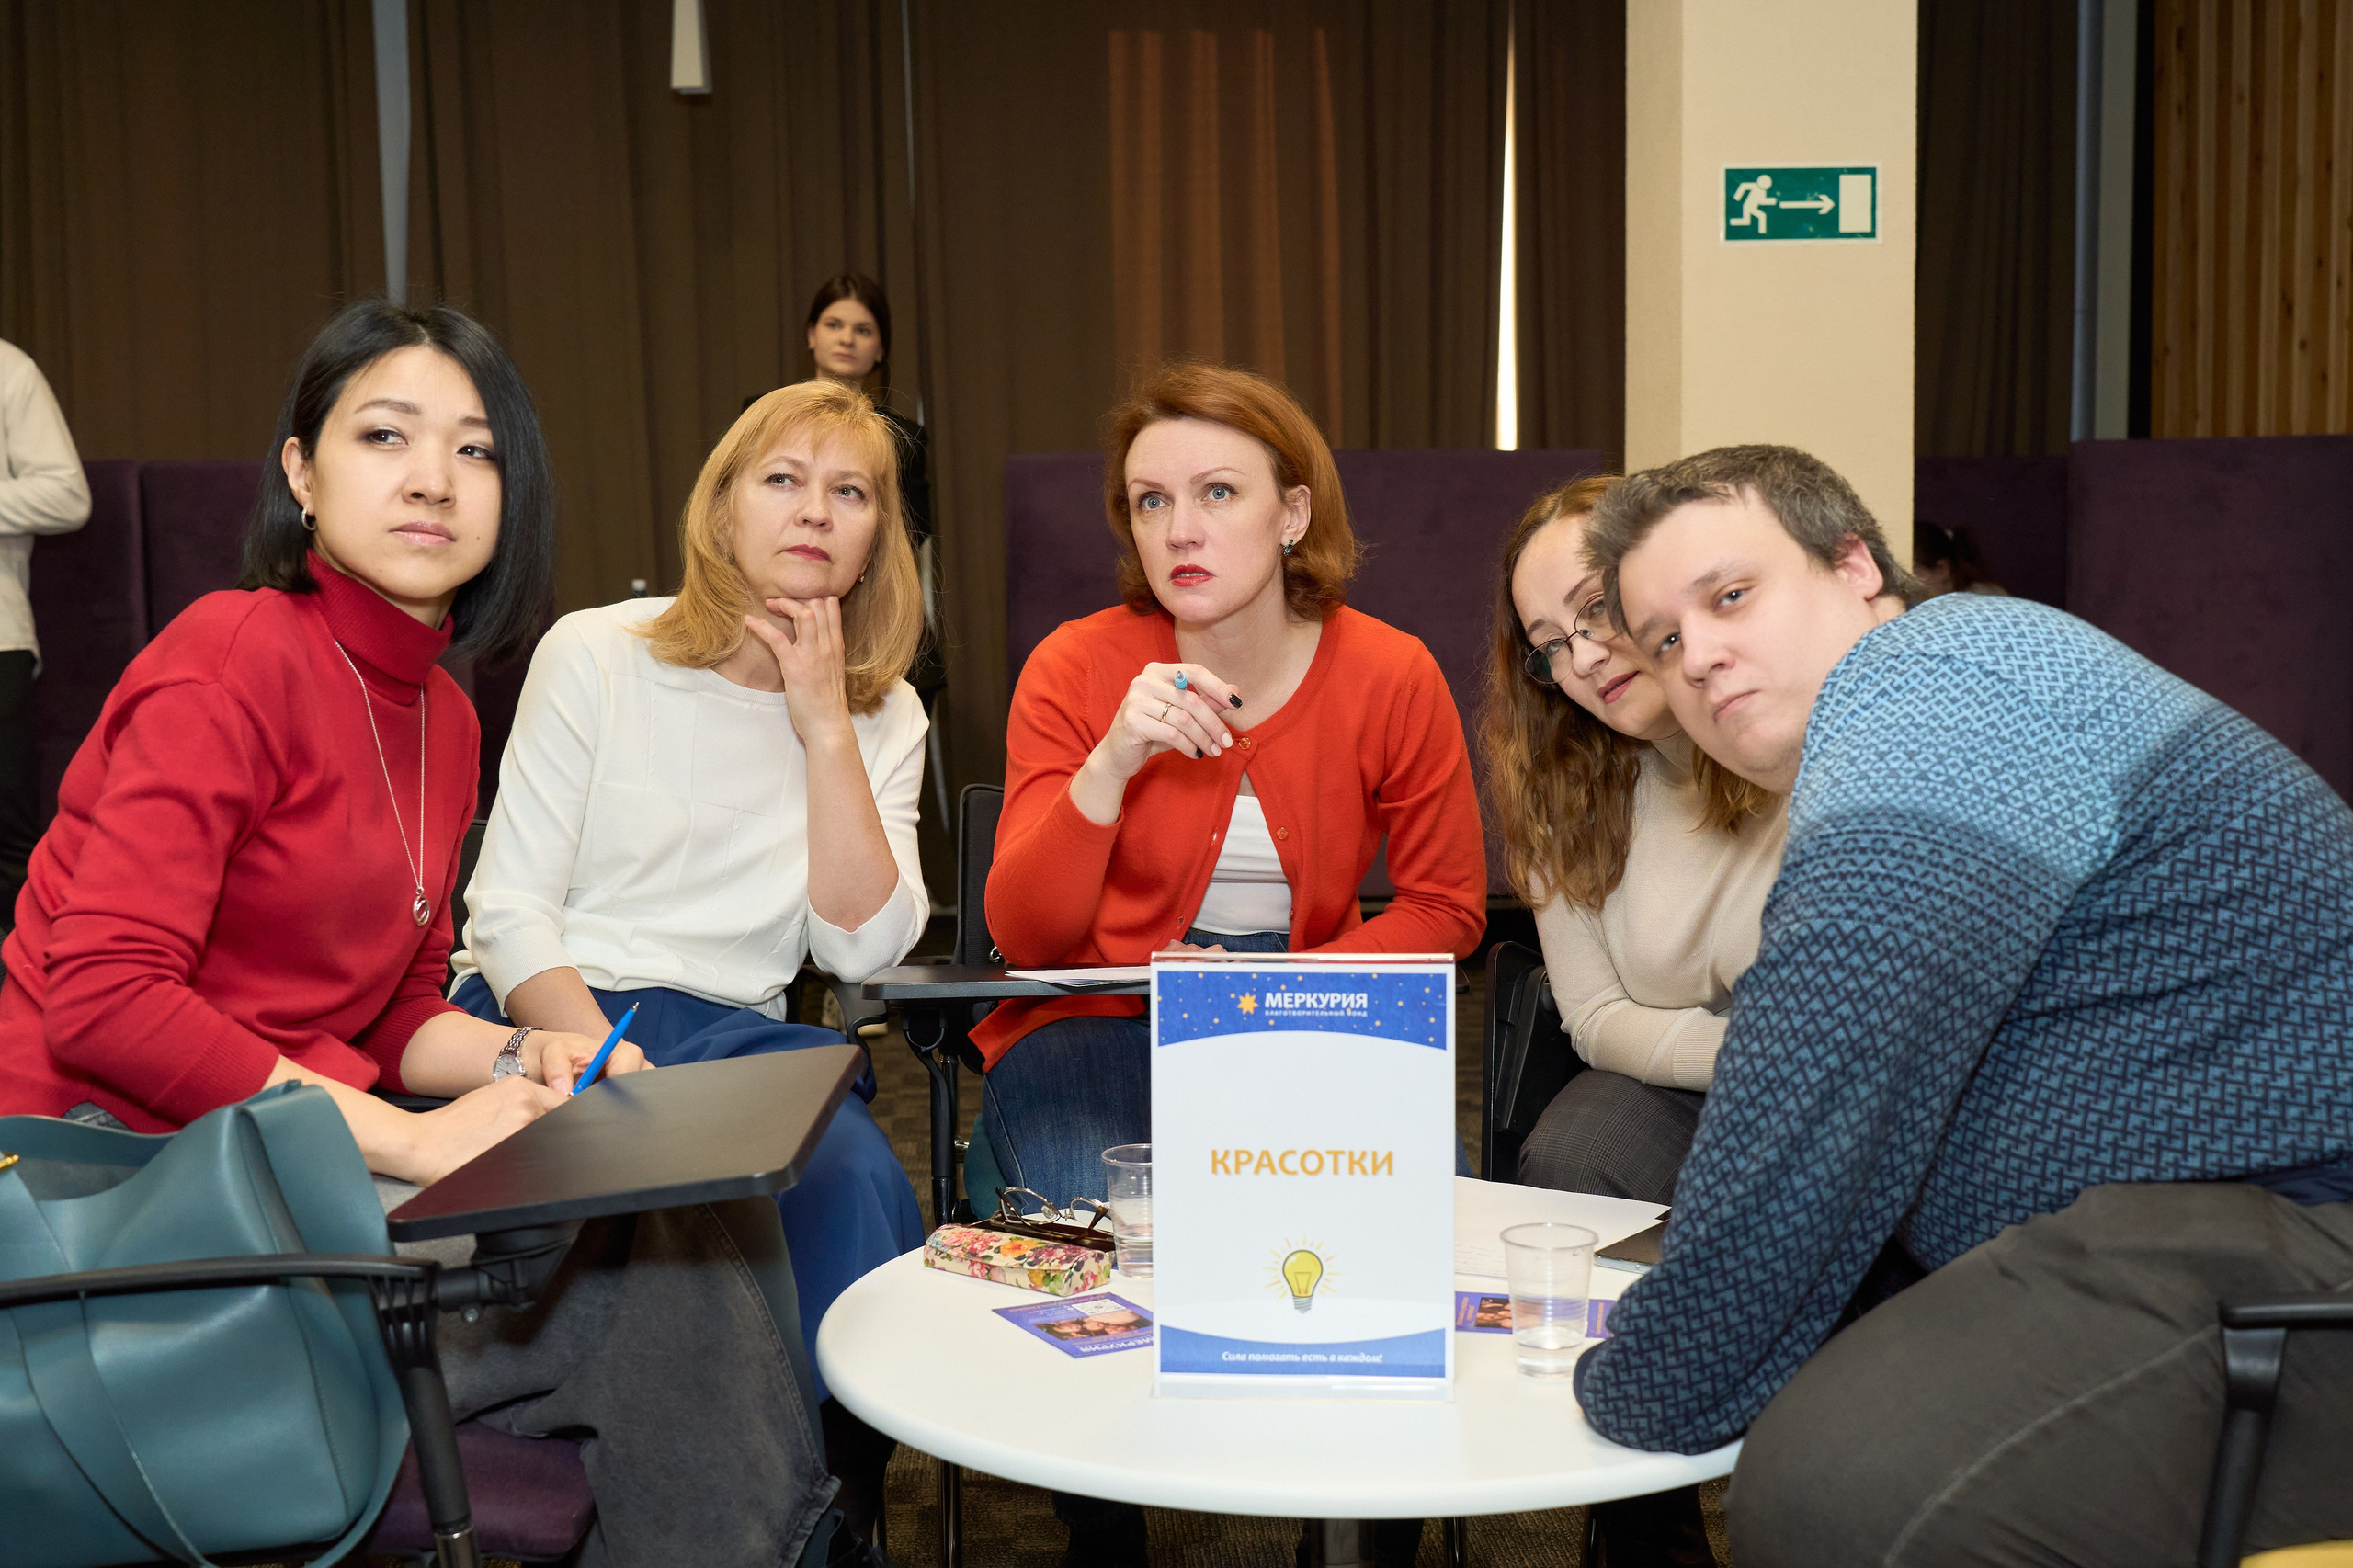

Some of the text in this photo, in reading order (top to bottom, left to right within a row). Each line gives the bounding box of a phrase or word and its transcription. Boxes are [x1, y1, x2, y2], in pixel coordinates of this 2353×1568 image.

[1265, 992, 1368, 1009] МЕРКУРИЯ
[1211, 1149, 1393, 1176] КРАСОТКИ
[1222, 1351, 1383, 1364] Сила помогать есть в каждом!
